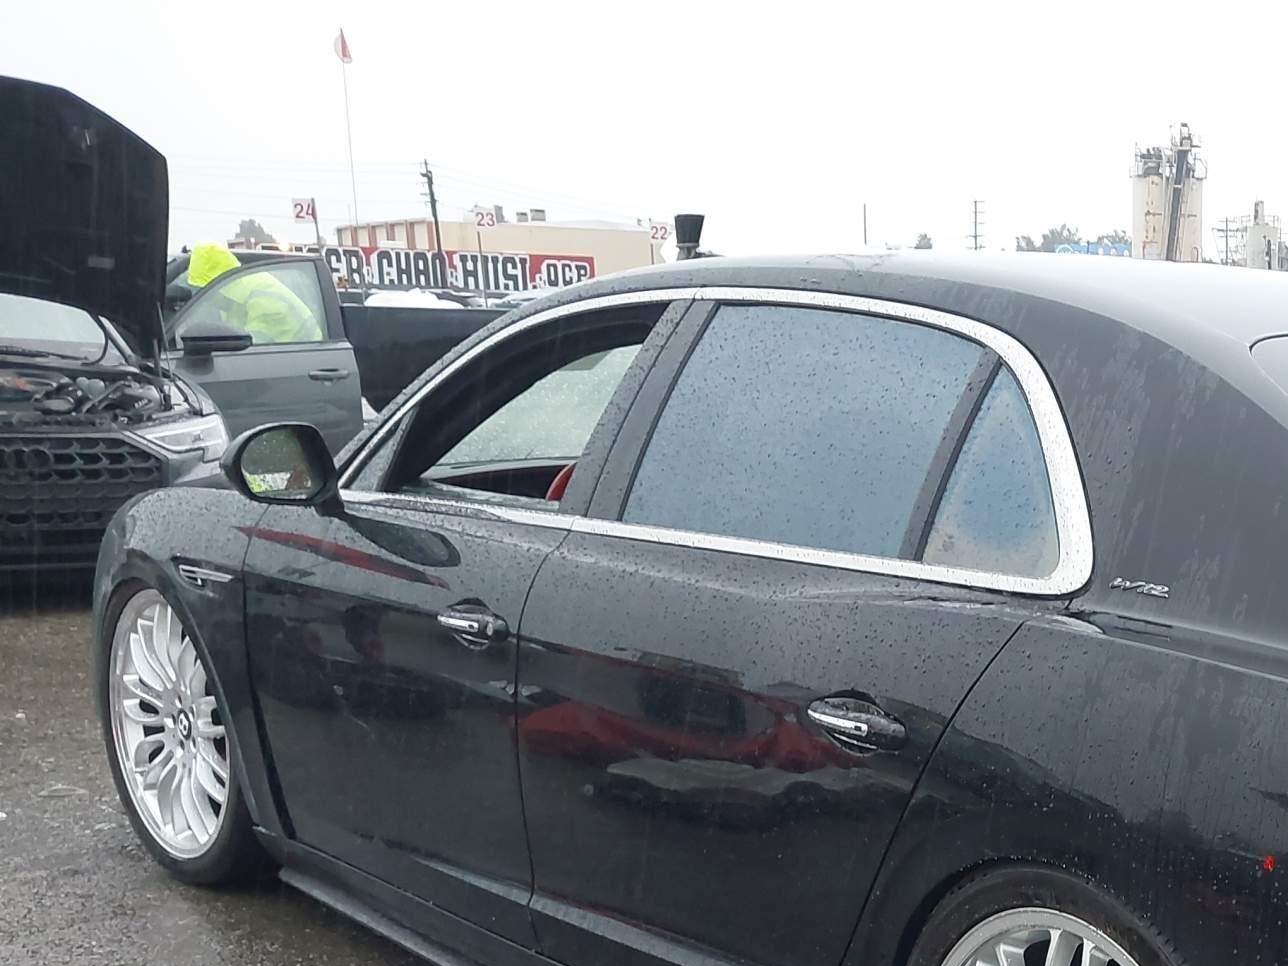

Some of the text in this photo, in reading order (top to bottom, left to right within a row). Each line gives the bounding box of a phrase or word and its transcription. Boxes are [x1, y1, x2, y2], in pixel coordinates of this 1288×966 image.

[294, 203, 315, 218] 24
[475, 212, 496, 227] 23
[651, 226, 668, 240] 22
